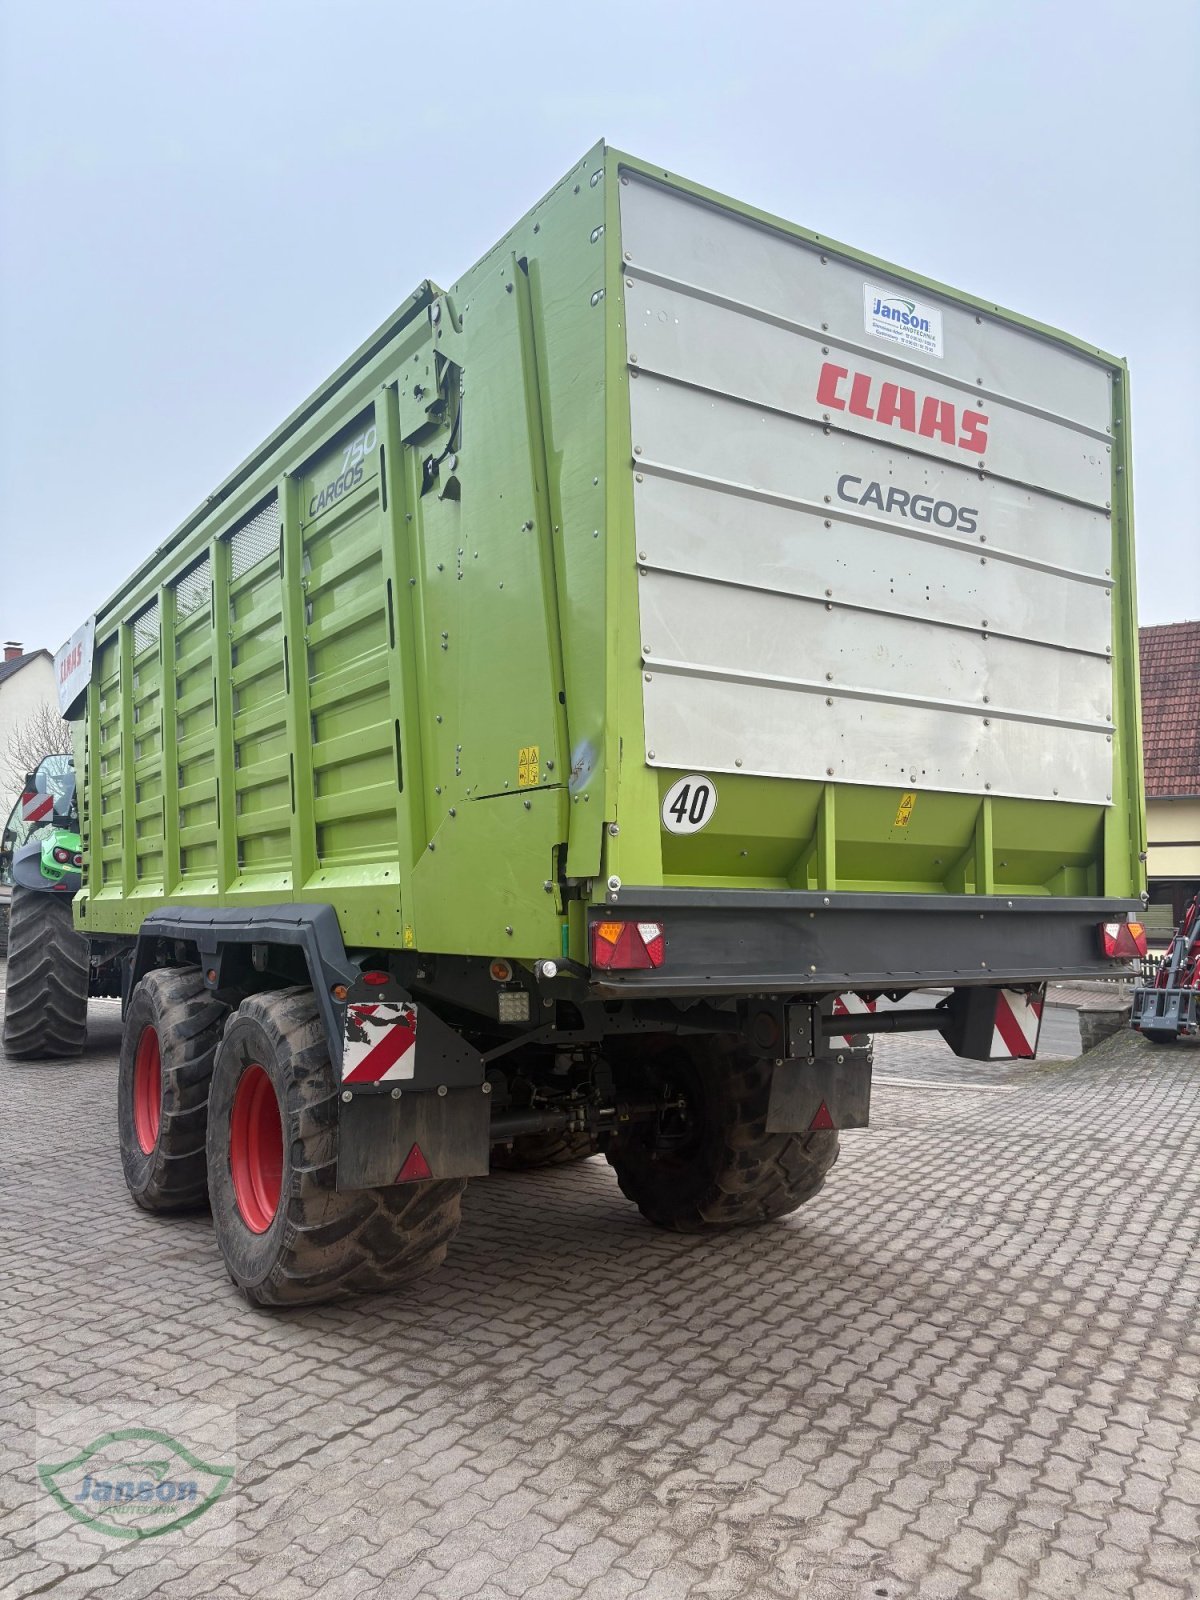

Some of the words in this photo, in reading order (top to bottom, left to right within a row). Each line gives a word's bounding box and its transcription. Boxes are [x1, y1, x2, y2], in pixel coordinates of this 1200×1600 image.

[873, 299, 929, 332] Janson
[816, 362, 989, 454] CLAAS
[343, 424, 377, 475] 750
[309, 458, 365, 517] CARGOS
[837, 474, 979, 533] CARGOS
[669, 784, 710, 824] 40
